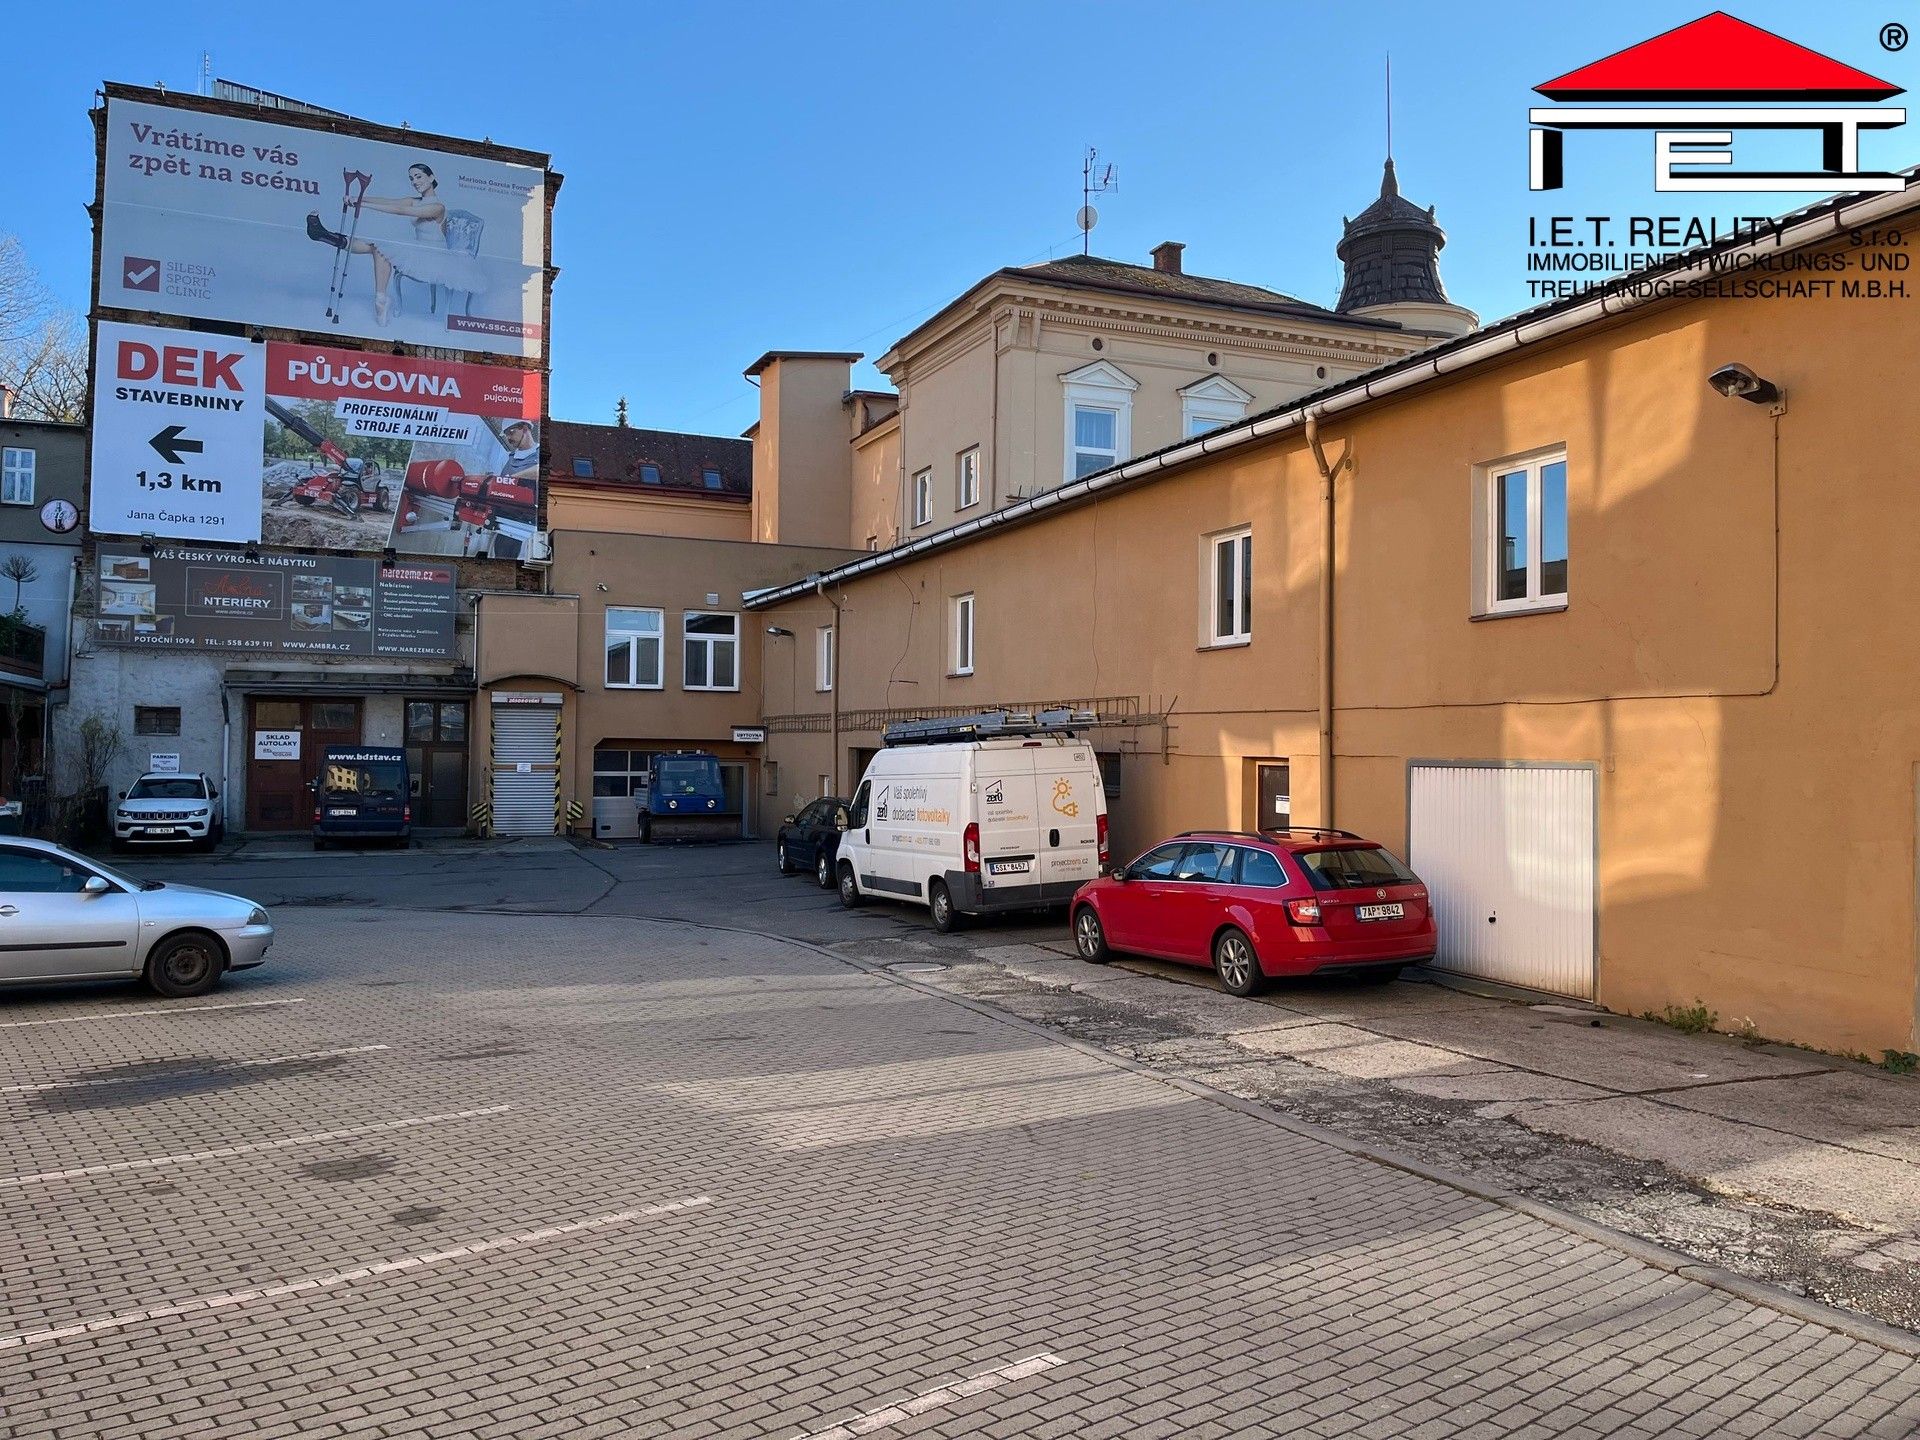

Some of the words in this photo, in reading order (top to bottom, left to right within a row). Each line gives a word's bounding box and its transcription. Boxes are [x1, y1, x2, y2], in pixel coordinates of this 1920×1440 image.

[130, 122, 245, 158] Vrátíme
[253, 145, 298, 166] vás
[129, 153, 191, 177] zpět
[198, 163, 232, 183] na
[240, 171, 320, 195] scénu
[166, 261, 216, 277] SILESIA
[166, 274, 209, 287] SPORT
[166, 286, 212, 300] CLINIC
[456, 317, 533, 335] www.ssc.care
[116, 340, 245, 392] DEK
[287, 355, 462, 399] PŮJČOVNA
[115, 387, 244, 412] STAVEBNINY
[483, 393, 523, 404] pujcovna
[343, 402, 440, 422] PROFESIONÁLNÍ
[354, 419, 400, 434] STROJE
[403, 423, 411, 435] A
[415, 423, 469, 440] ZAŘÍZENÍ
[136, 471, 173, 491] 1,3
[182, 474, 222, 494] km
[496, 476, 516, 486] DEK
[127, 510, 155, 521] Jana
[158, 509, 195, 524] Čapka
[199, 515, 226, 526] 1291
[153, 551, 175, 560] VÁŠ
[178, 551, 213, 562] ČESKÝ
[268, 556, 316, 568] NÁBYTKU
[382, 568, 434, 581] narezeme.cz
[282, 641, 351, 650] WWW.AMBRA.CZ
[377, 645, 447, 654] WWW.NAREZEME.CZ
[328, 753, 402, 761] www.bdstav.cz
[1362, 907, 1377, 917] 7AP
[1381, 905, 1400, 916] 9842
